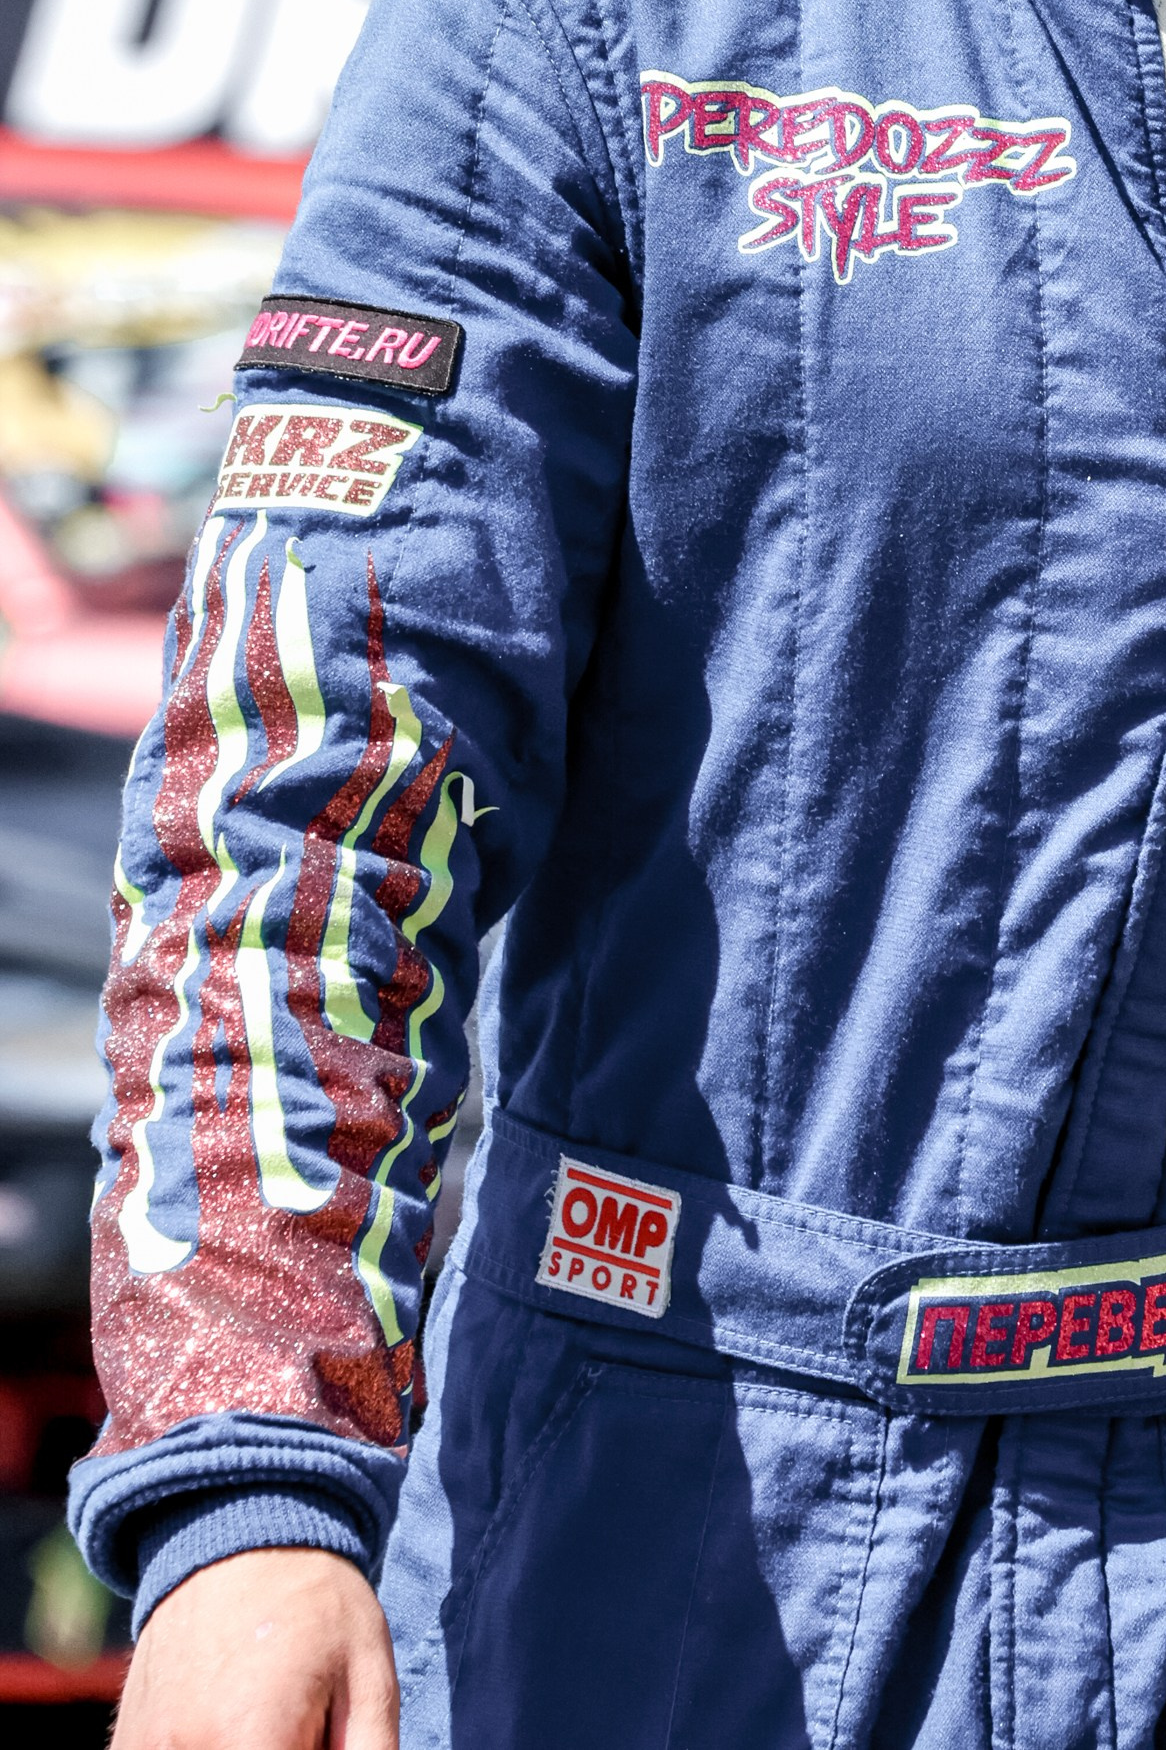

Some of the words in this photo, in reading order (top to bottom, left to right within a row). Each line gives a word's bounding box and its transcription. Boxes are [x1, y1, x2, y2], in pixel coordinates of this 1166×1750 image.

[741, 174, 959, 278] STYLE
[224, 414, 412, 477] KRZ
[218, 471, 383, 507] SERVICE
[561, 1186, 668, 1259] OMP
[548, 1251, 659, 1306] SPORT
